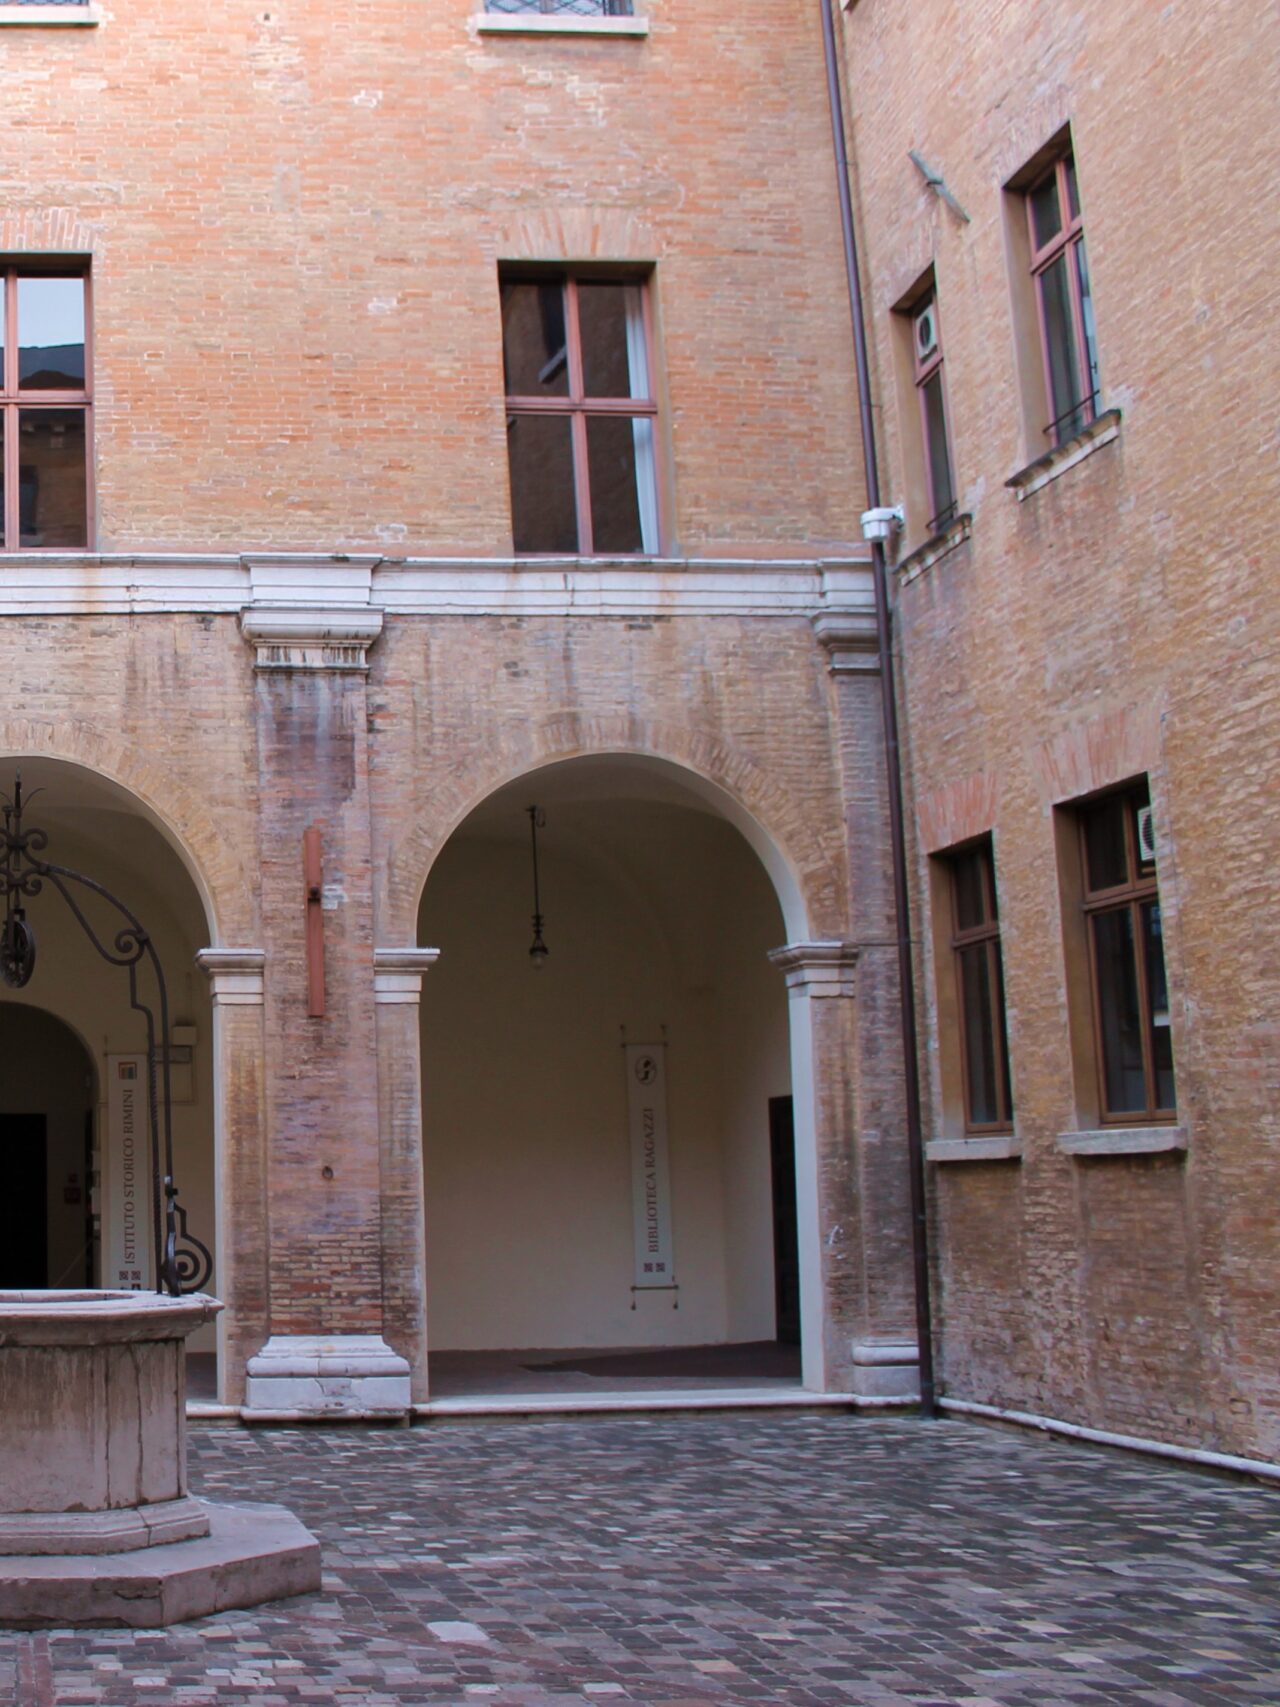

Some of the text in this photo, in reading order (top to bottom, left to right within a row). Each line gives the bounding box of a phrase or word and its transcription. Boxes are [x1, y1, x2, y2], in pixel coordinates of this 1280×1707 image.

[122, 1089, 135, 1265] ISTITUTO STORICO RIMINI
[643, 1108, 659, 1253] BIBLIOTECA RAGAZZI
